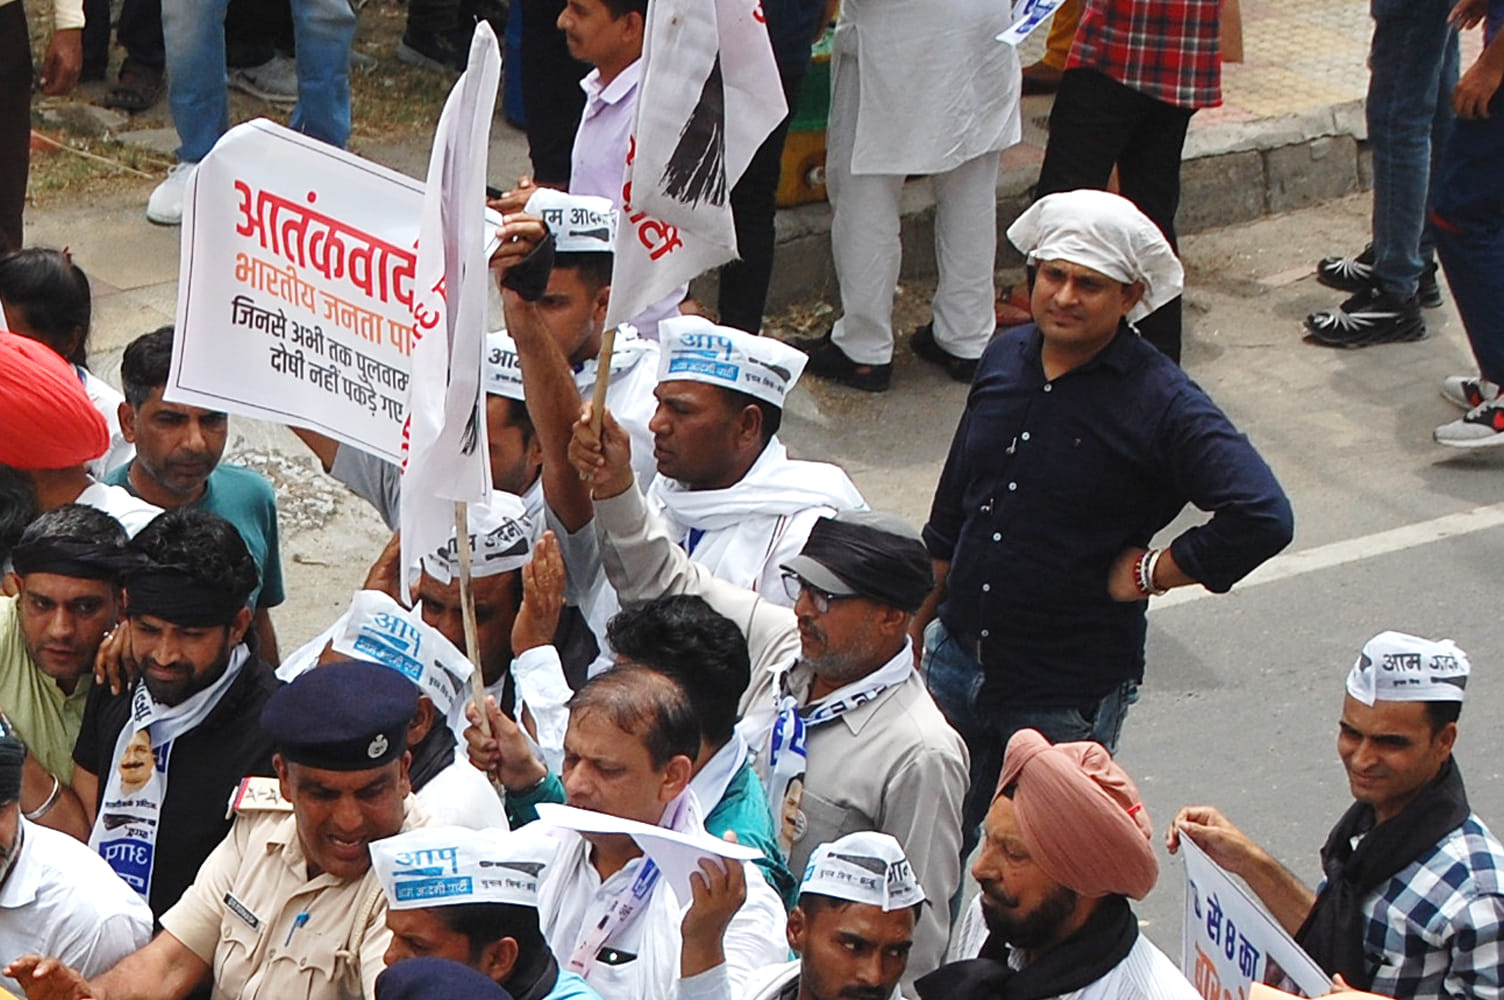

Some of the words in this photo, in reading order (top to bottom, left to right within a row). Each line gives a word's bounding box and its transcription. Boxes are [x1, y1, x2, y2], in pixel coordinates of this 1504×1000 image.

[234, 179, 419, 313] आतंकवाद
[235, 251, 316, 315] भारतीय
[319, 290, 383, 345] जनता
[231, 294, 288, 340] जिनसे
[291, 321, 326, 356] अभी
[327, 338, 353, 368] तक
[354, 351, 410, 392] पुलवाम
[270, 342, 305, 380] दोषी
[308, 361, 342, 394] नहीं
[680, 332, 733, 361] आप
[374, 611, 422, 658] आप
[1382, 652, 1421, 672] आम
[394, 846, 459, 875] आप
[1207, 892, 1224, 947] से
[1239, 932, 1261, 982] का
